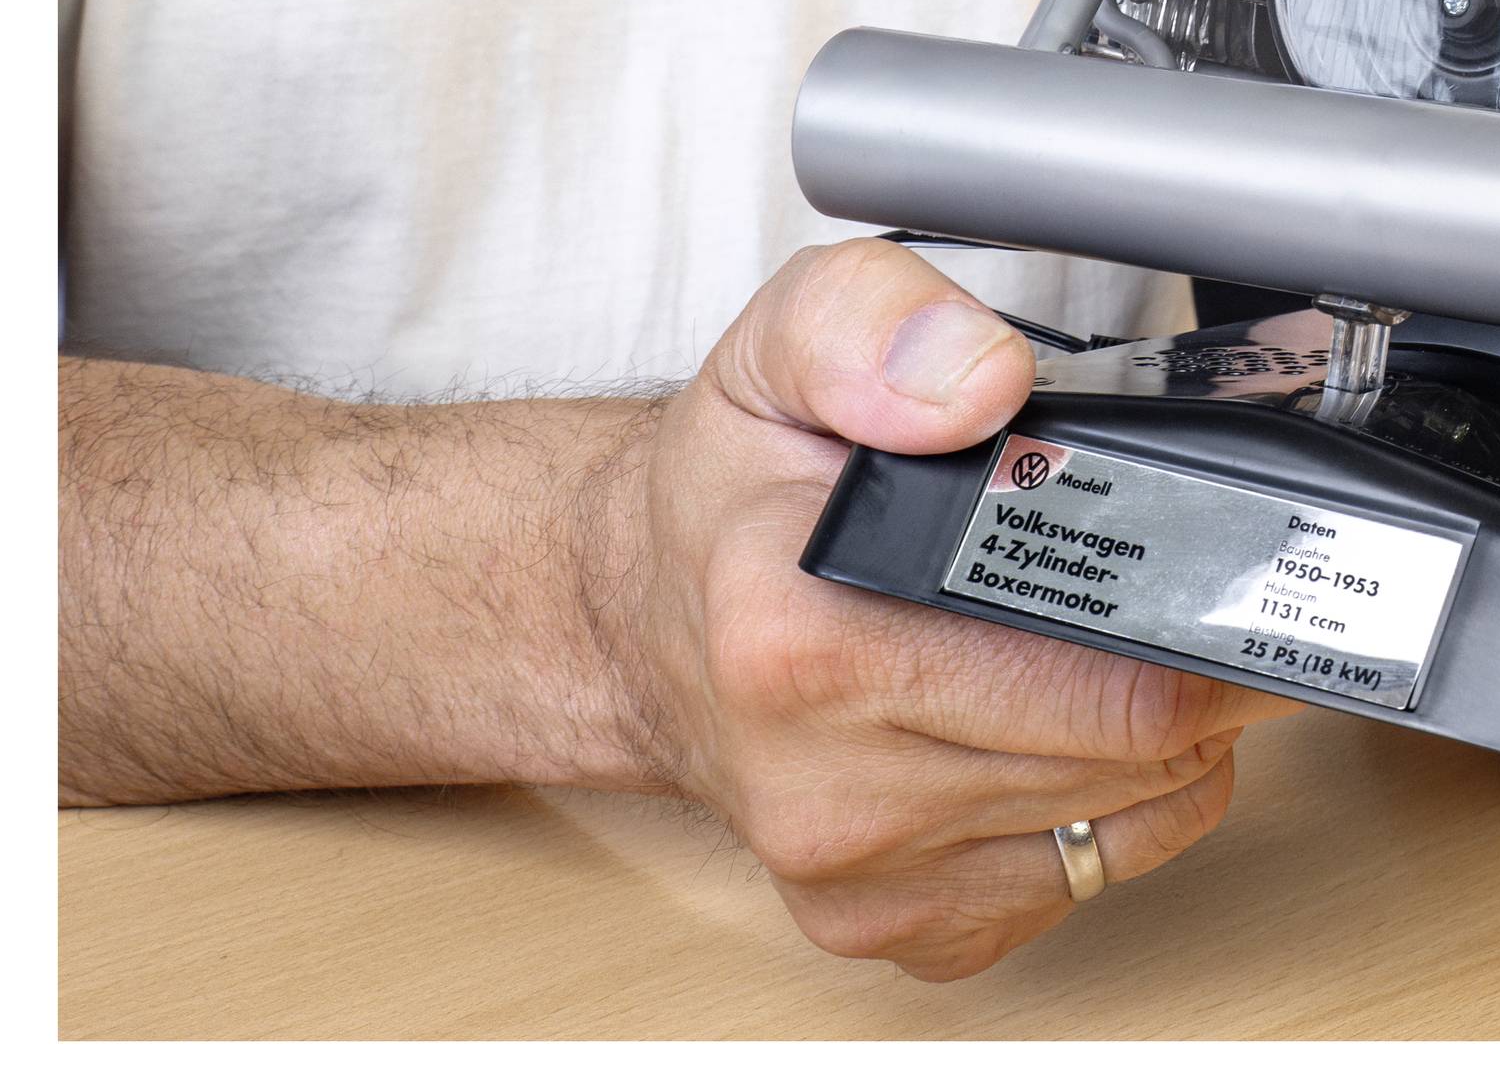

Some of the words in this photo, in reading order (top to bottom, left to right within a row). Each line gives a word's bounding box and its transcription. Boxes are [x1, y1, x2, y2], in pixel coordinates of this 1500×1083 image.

[1055, 472, 1113, 497] Modell
[996, 503, 1147, 561] Volkswagen
[1287, 515, 1337, 539] Daten
[979, 533, 1120, 584] 4-Zylinder-
[1278, 540, 1331, 563] Baujahre
[966, 561, 1119, 618] Boxermotor
[1263, 580, 1318, 604] Hubraum
[1260, 597, 1303, 622] 1131
[1309, 615, 1346, 634] ccm
[1248, 621, 1296, 646] Leistung
[1240, 637, 1269, 658] 25
[1272, 645, 1300, 666] PS
[1301, 653, 1335, 676] (18
[1338, 660, 1382, 692] kW)
